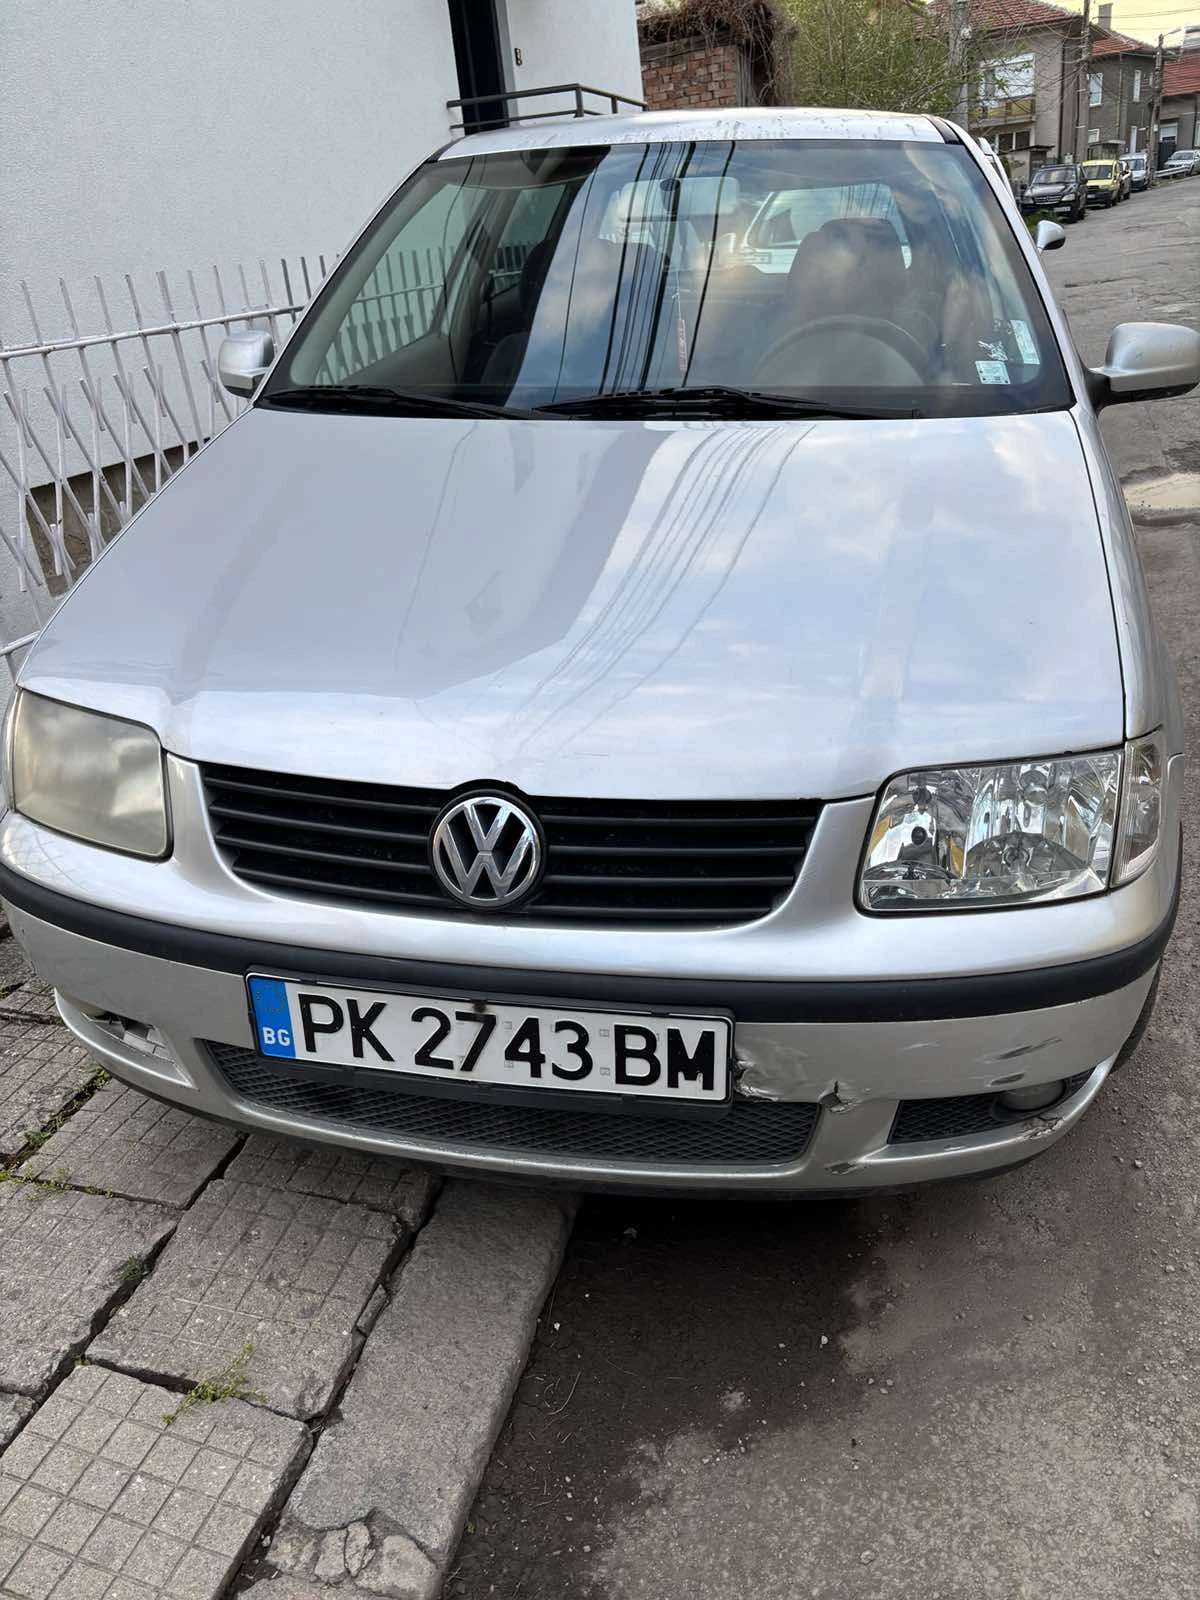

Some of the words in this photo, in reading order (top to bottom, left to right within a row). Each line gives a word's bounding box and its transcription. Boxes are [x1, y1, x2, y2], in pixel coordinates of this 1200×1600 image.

[436, 799, 537, 900] VW
[263, 1026, 291, 1047] BG
[297, 992, 395, 1062] PK
[411, 1007, 594, 1081] 2743
[613, 1024, 716, 1091] BM
